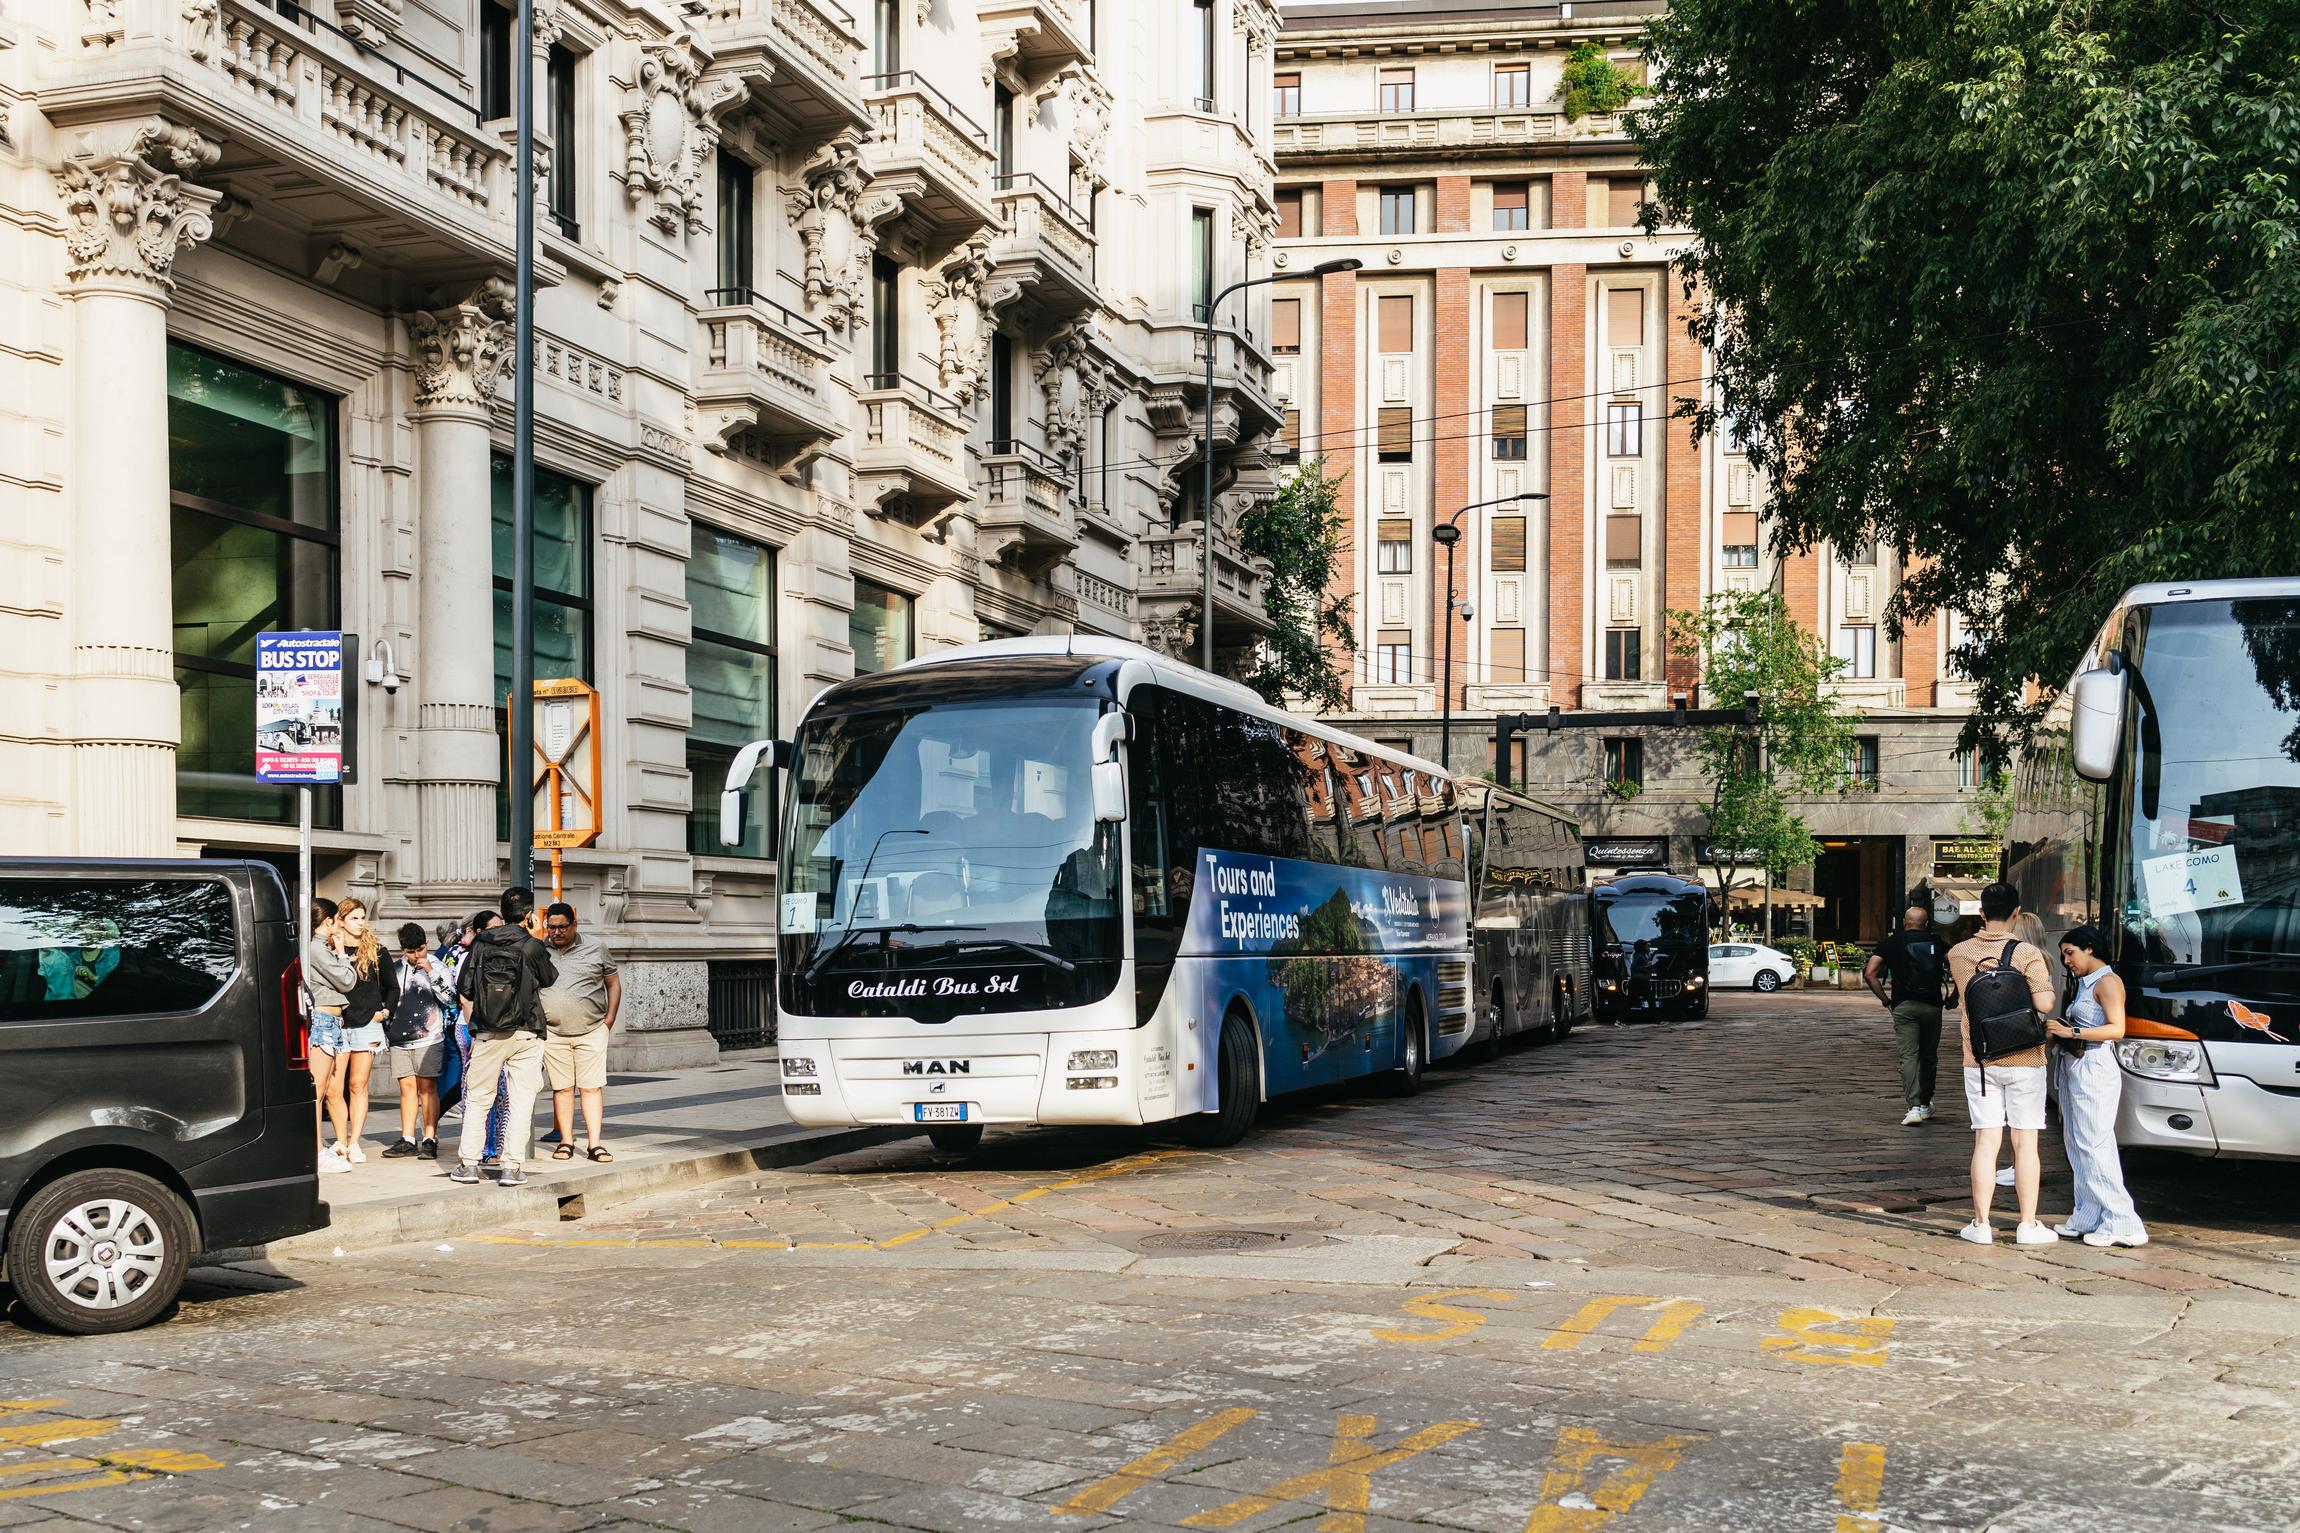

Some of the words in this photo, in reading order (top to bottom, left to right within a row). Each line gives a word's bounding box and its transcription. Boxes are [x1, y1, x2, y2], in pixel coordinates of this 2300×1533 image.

[277, 639, 340, 647] Autostradale
[261, 651, 294, 668] BUS
[296, 650, 339, 667] STOP
[1589, 846, 1655, 859] Quintessenza
[2155, 861, 2182, 873] LAKE
[2186, 854, 2220, 867] COMO
[1205, 854, 1248, 895] Tours
[1250, 860, 1276, 897] and
[2184, 878, 2197, 895] 4
[787, 906, 796, 927] 1
[1220, 900, 1300, 950] Experiences
[848, 978, 927, 998] Cataldi
[933, 976, 980, 996] Bus
[984, 974, 1020, 994] Srl
[903, 1060, 970, 1075] MAN
[29, 1226, 44, 1276] KUMHO
